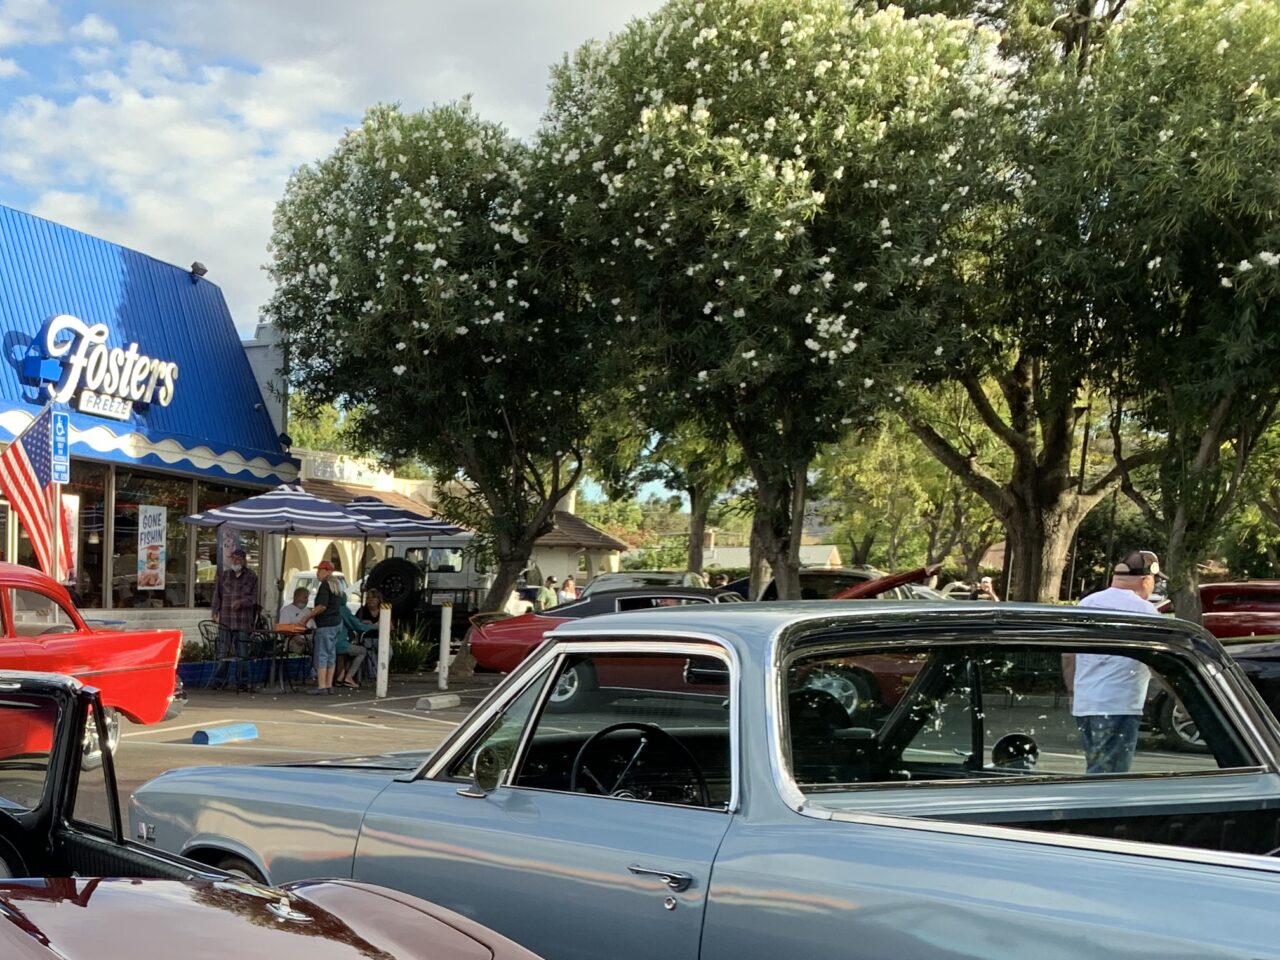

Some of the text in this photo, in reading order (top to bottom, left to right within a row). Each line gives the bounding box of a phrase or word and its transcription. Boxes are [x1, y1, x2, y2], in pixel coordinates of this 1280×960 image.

[46, 313, 179, 408] Fosters
[86, 395, 129, 416] FREEZE
[142, 512, 162, 529] GONE
